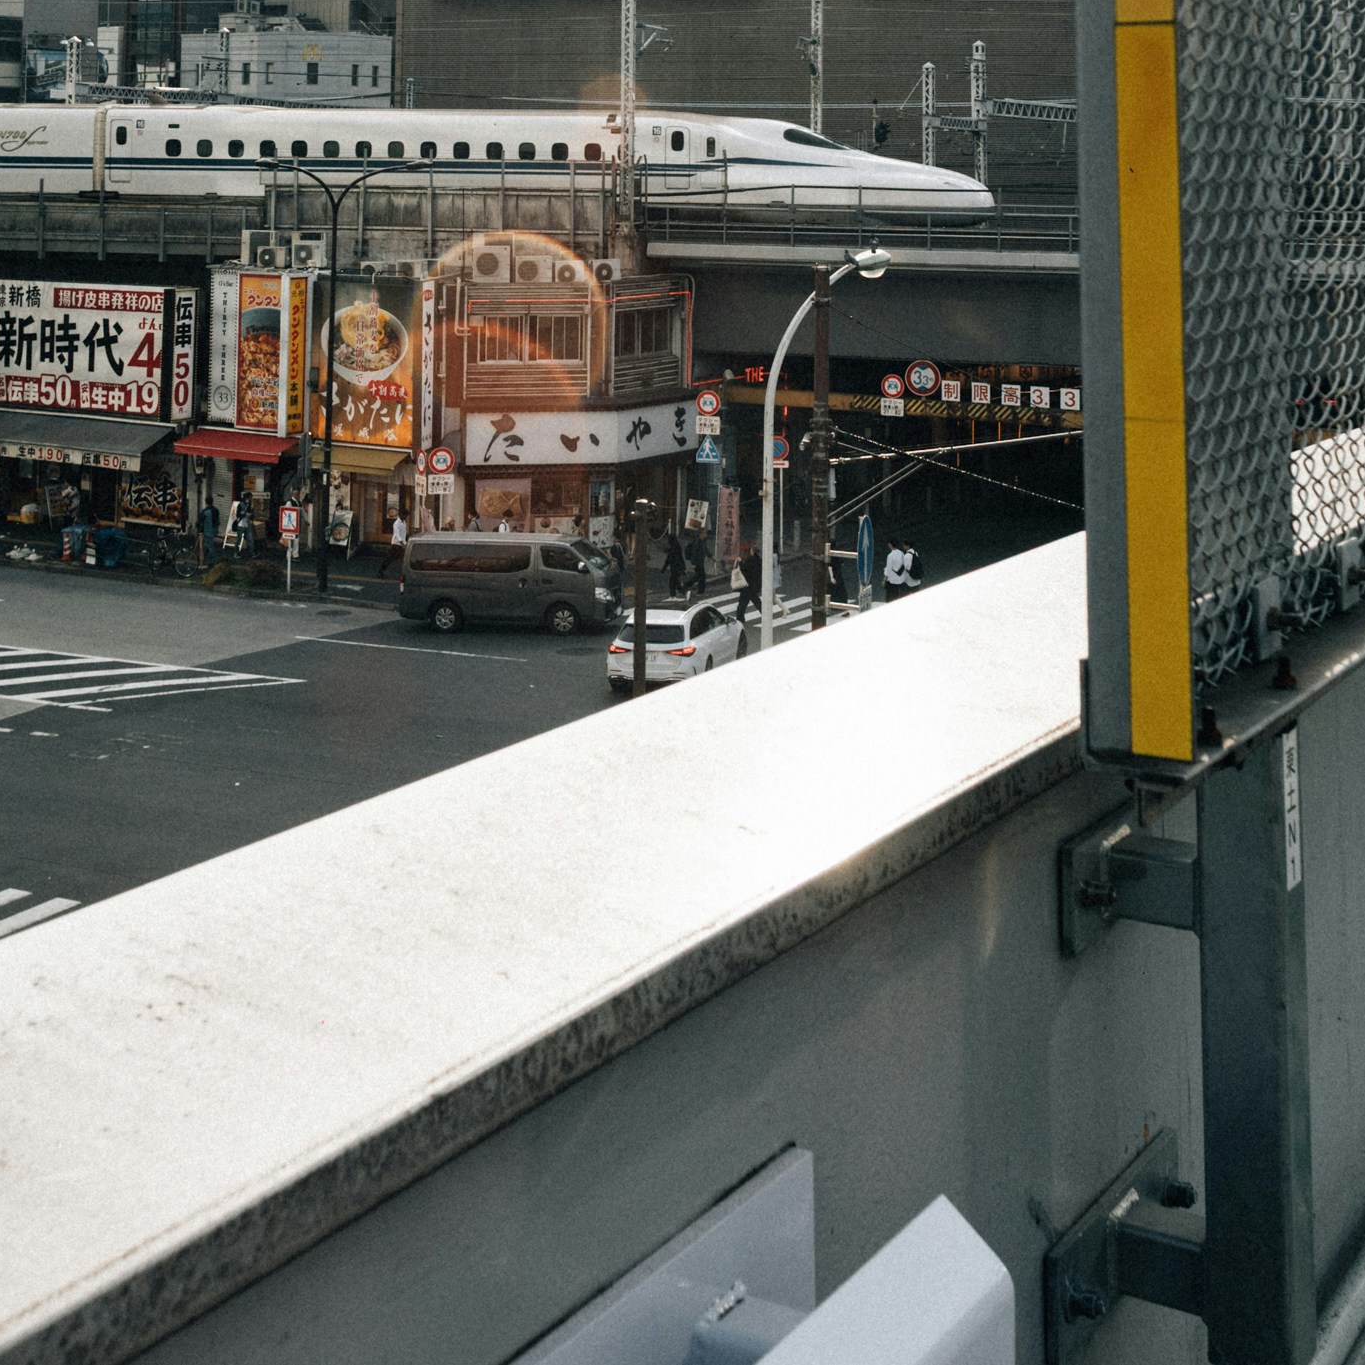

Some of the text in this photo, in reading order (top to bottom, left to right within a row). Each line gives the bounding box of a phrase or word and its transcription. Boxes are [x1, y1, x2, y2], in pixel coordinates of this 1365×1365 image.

[137, 120, 145, 129] 16
[652, 126, 662, 136] 16
[0, 284, 6, 308] 東京
[9, 286, 42, 308] 新橋
[744, 366, 764, 383] THE
[217, 391, 229, 403] 33
[483, 406, 687, 463] たいやき
[18, 445, 71, 463] 生中190円
[82, 453, 127, 470] 伝串50円
[125, 474, 179, 514] 伝串
